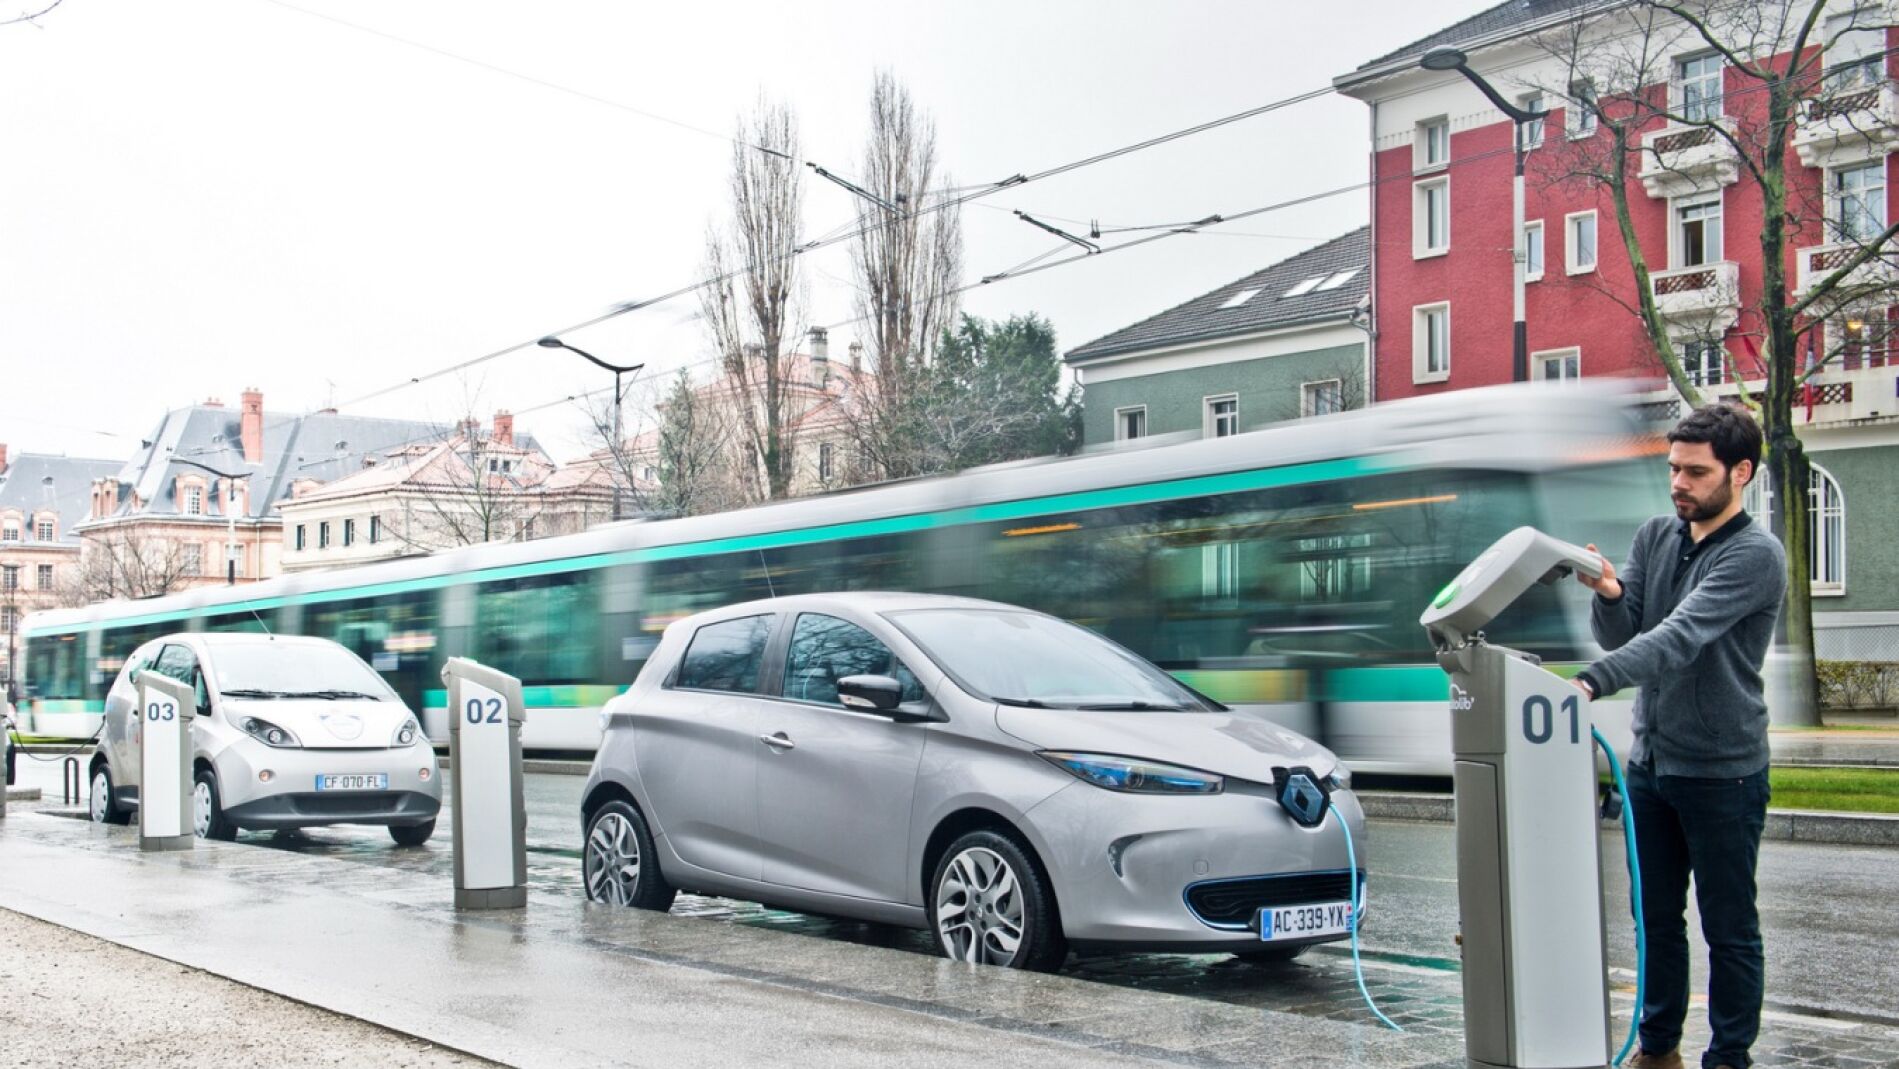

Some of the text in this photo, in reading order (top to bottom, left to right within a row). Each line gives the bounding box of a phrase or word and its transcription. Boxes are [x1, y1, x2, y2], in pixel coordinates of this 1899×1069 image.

[148, 702, 174, 721] 03
[466, 698, 503, 724] 02
[1522, 694, 1579, 745] 01
[1273, 905, 1344, 933] AC-339-YX
